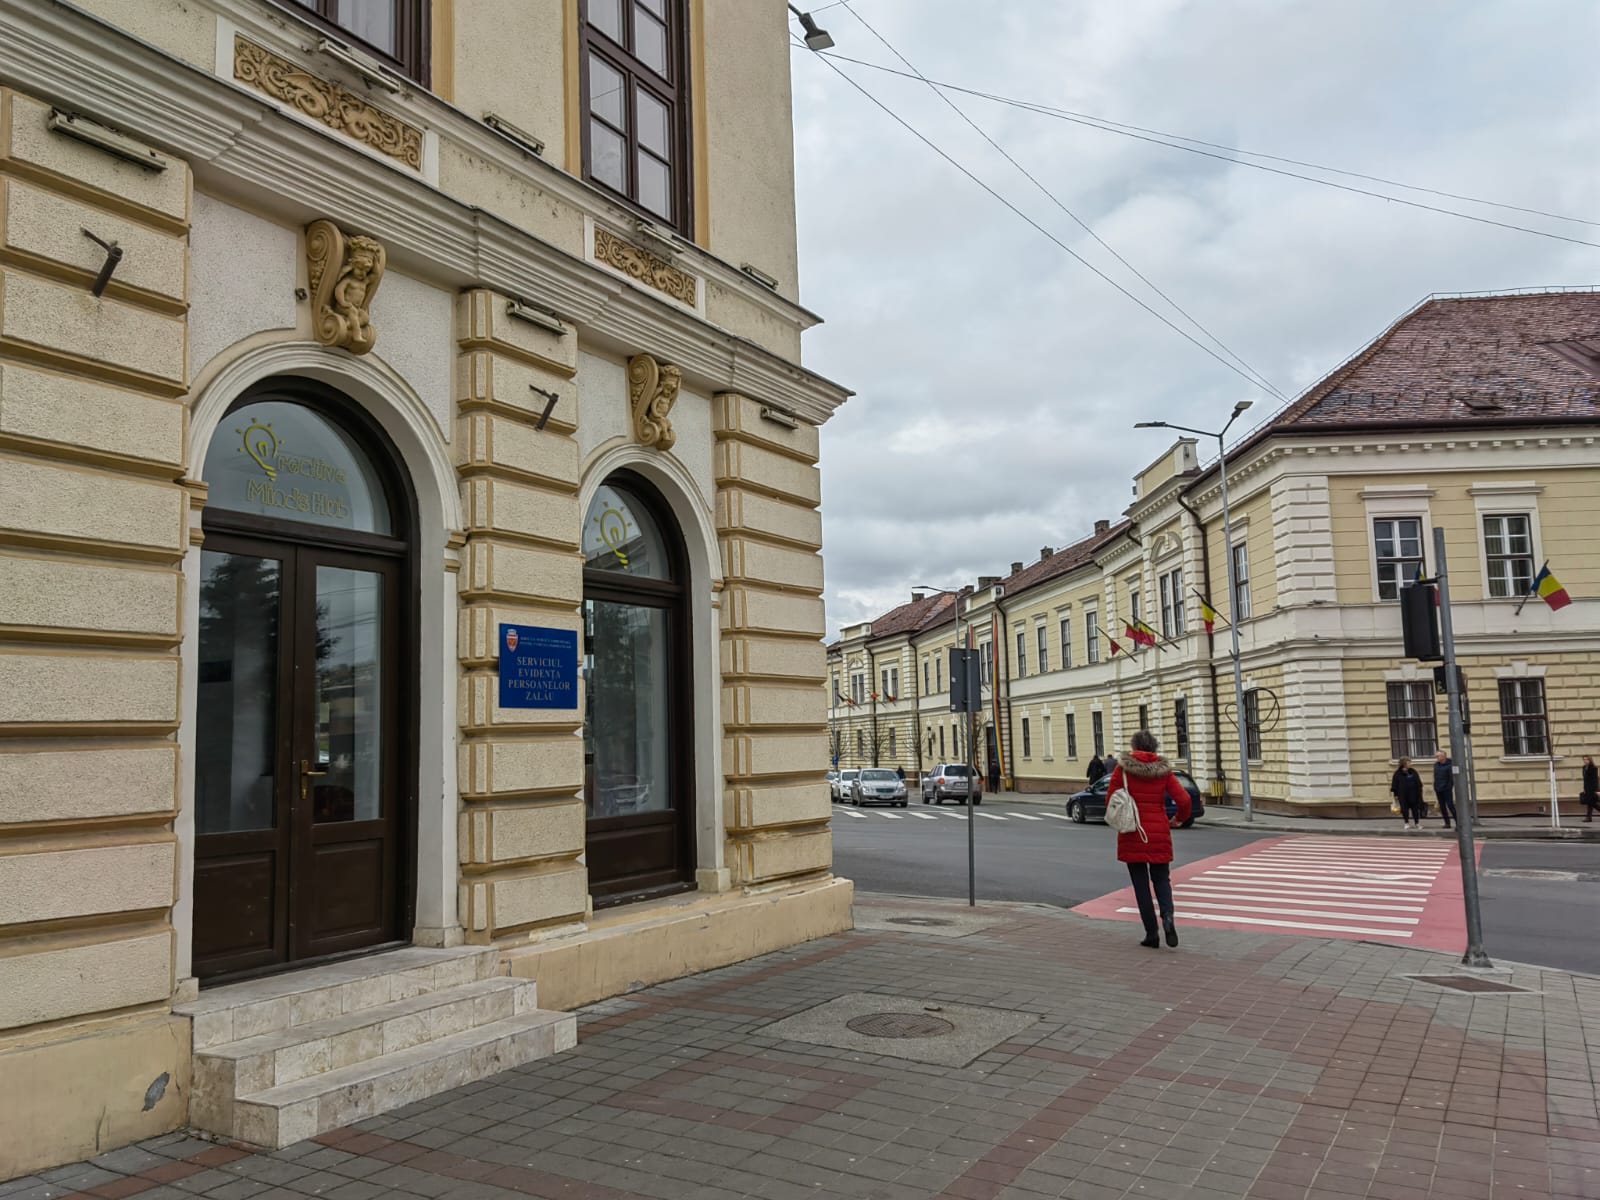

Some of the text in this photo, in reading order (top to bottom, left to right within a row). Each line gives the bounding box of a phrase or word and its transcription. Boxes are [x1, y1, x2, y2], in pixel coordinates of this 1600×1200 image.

[247, 478, 349, 519] Minds Hub
[516, 656, 563, 668] SERVICIUL
[508, 679, 571, 691] PERSOANELOR
